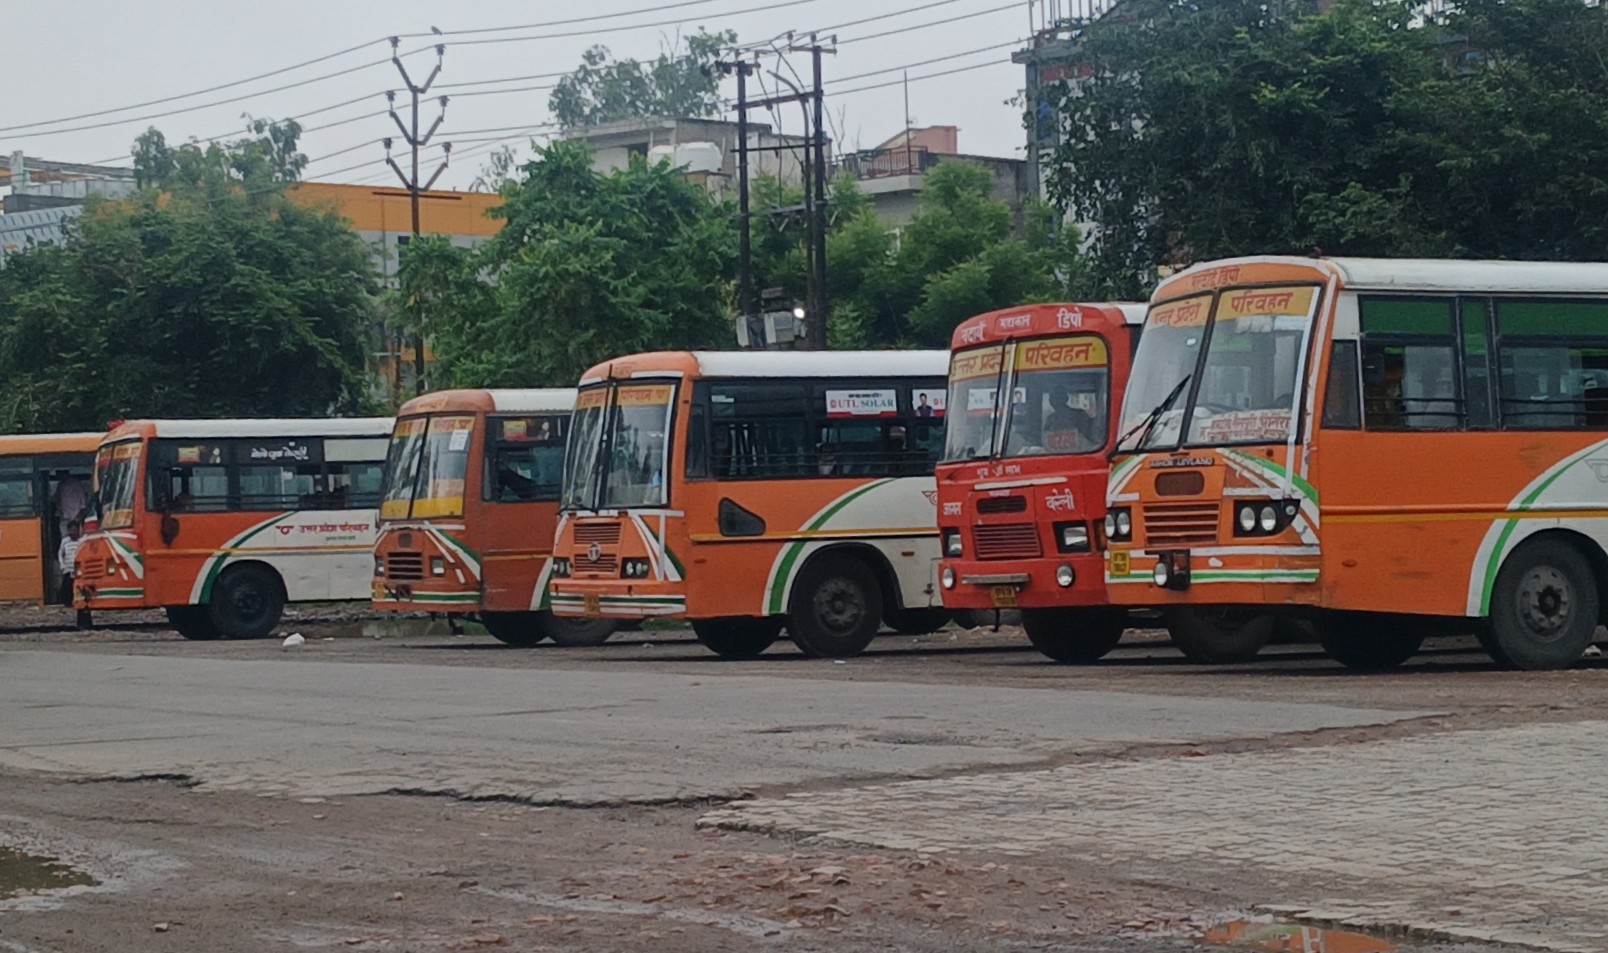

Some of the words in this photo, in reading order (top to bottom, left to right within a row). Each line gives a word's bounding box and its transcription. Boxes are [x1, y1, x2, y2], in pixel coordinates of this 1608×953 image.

[1231, 290, 1294, 314] परिवहन
[1057, 307, 1083, 329] डिपो
[1025, 342, 1093, 365] परिवहन
[838, 399, 858, 409] UTL
[861, 398, 894, 408] SOLAR
